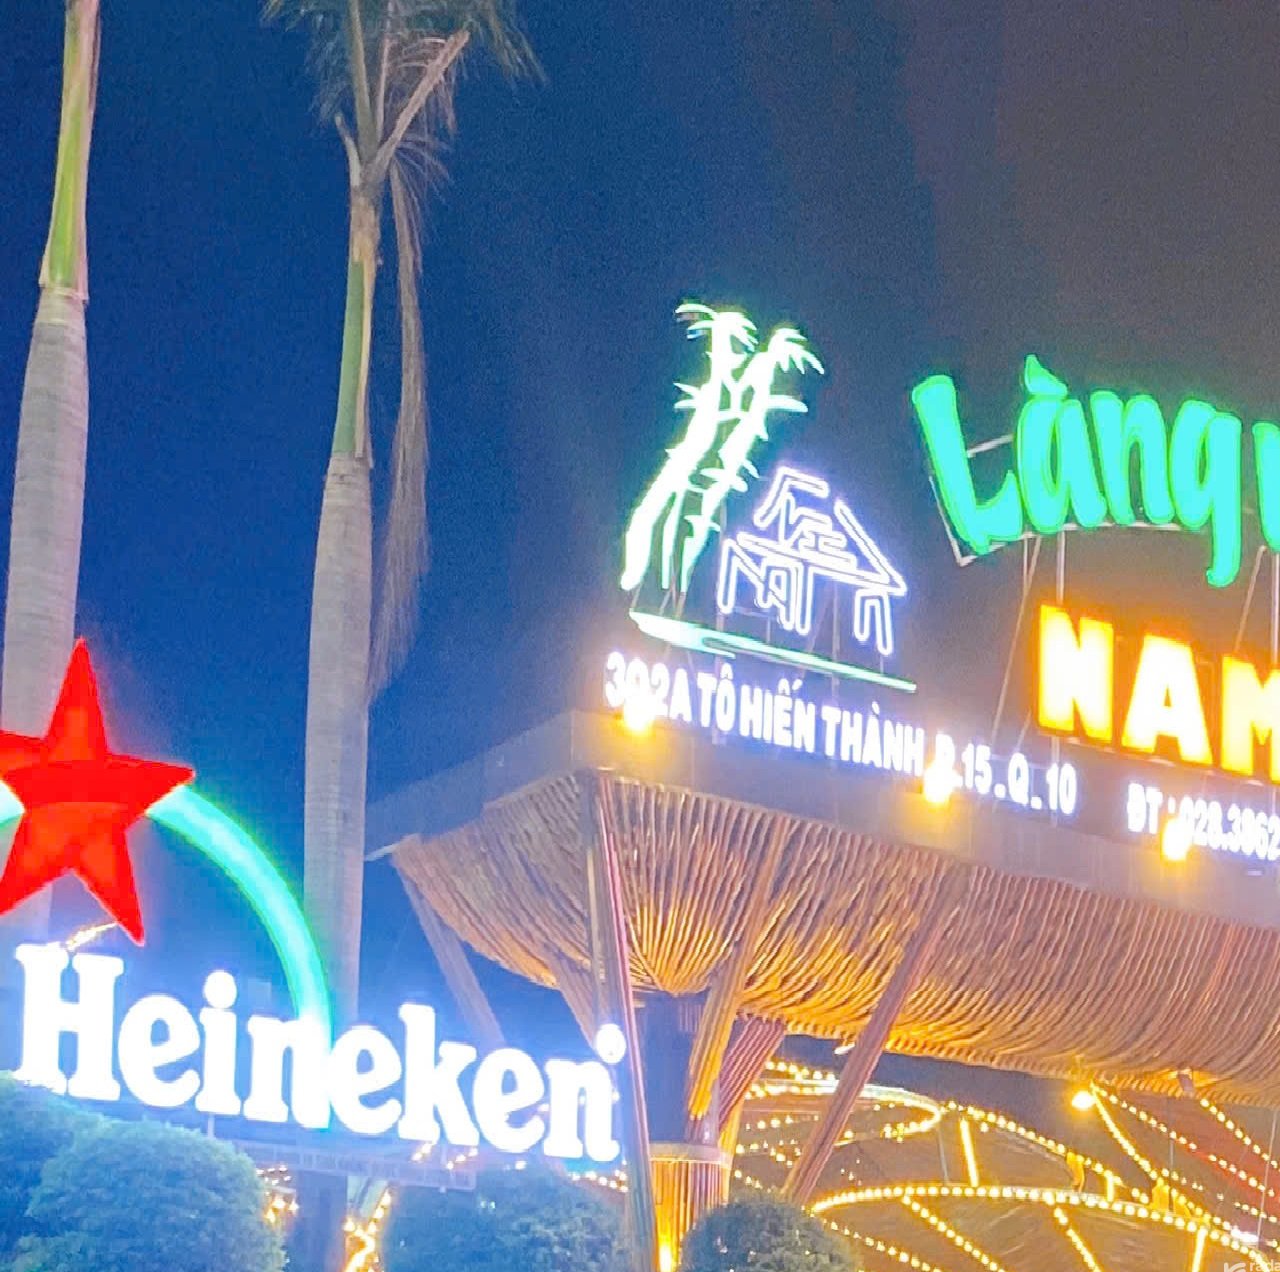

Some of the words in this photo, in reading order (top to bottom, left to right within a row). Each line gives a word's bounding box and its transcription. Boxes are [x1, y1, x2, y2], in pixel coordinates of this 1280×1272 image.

[912, 354, 1241, 588] Làng
[821, 700, 925, 777] THÀNH
[10, 943, 624, 1162] Heineken
